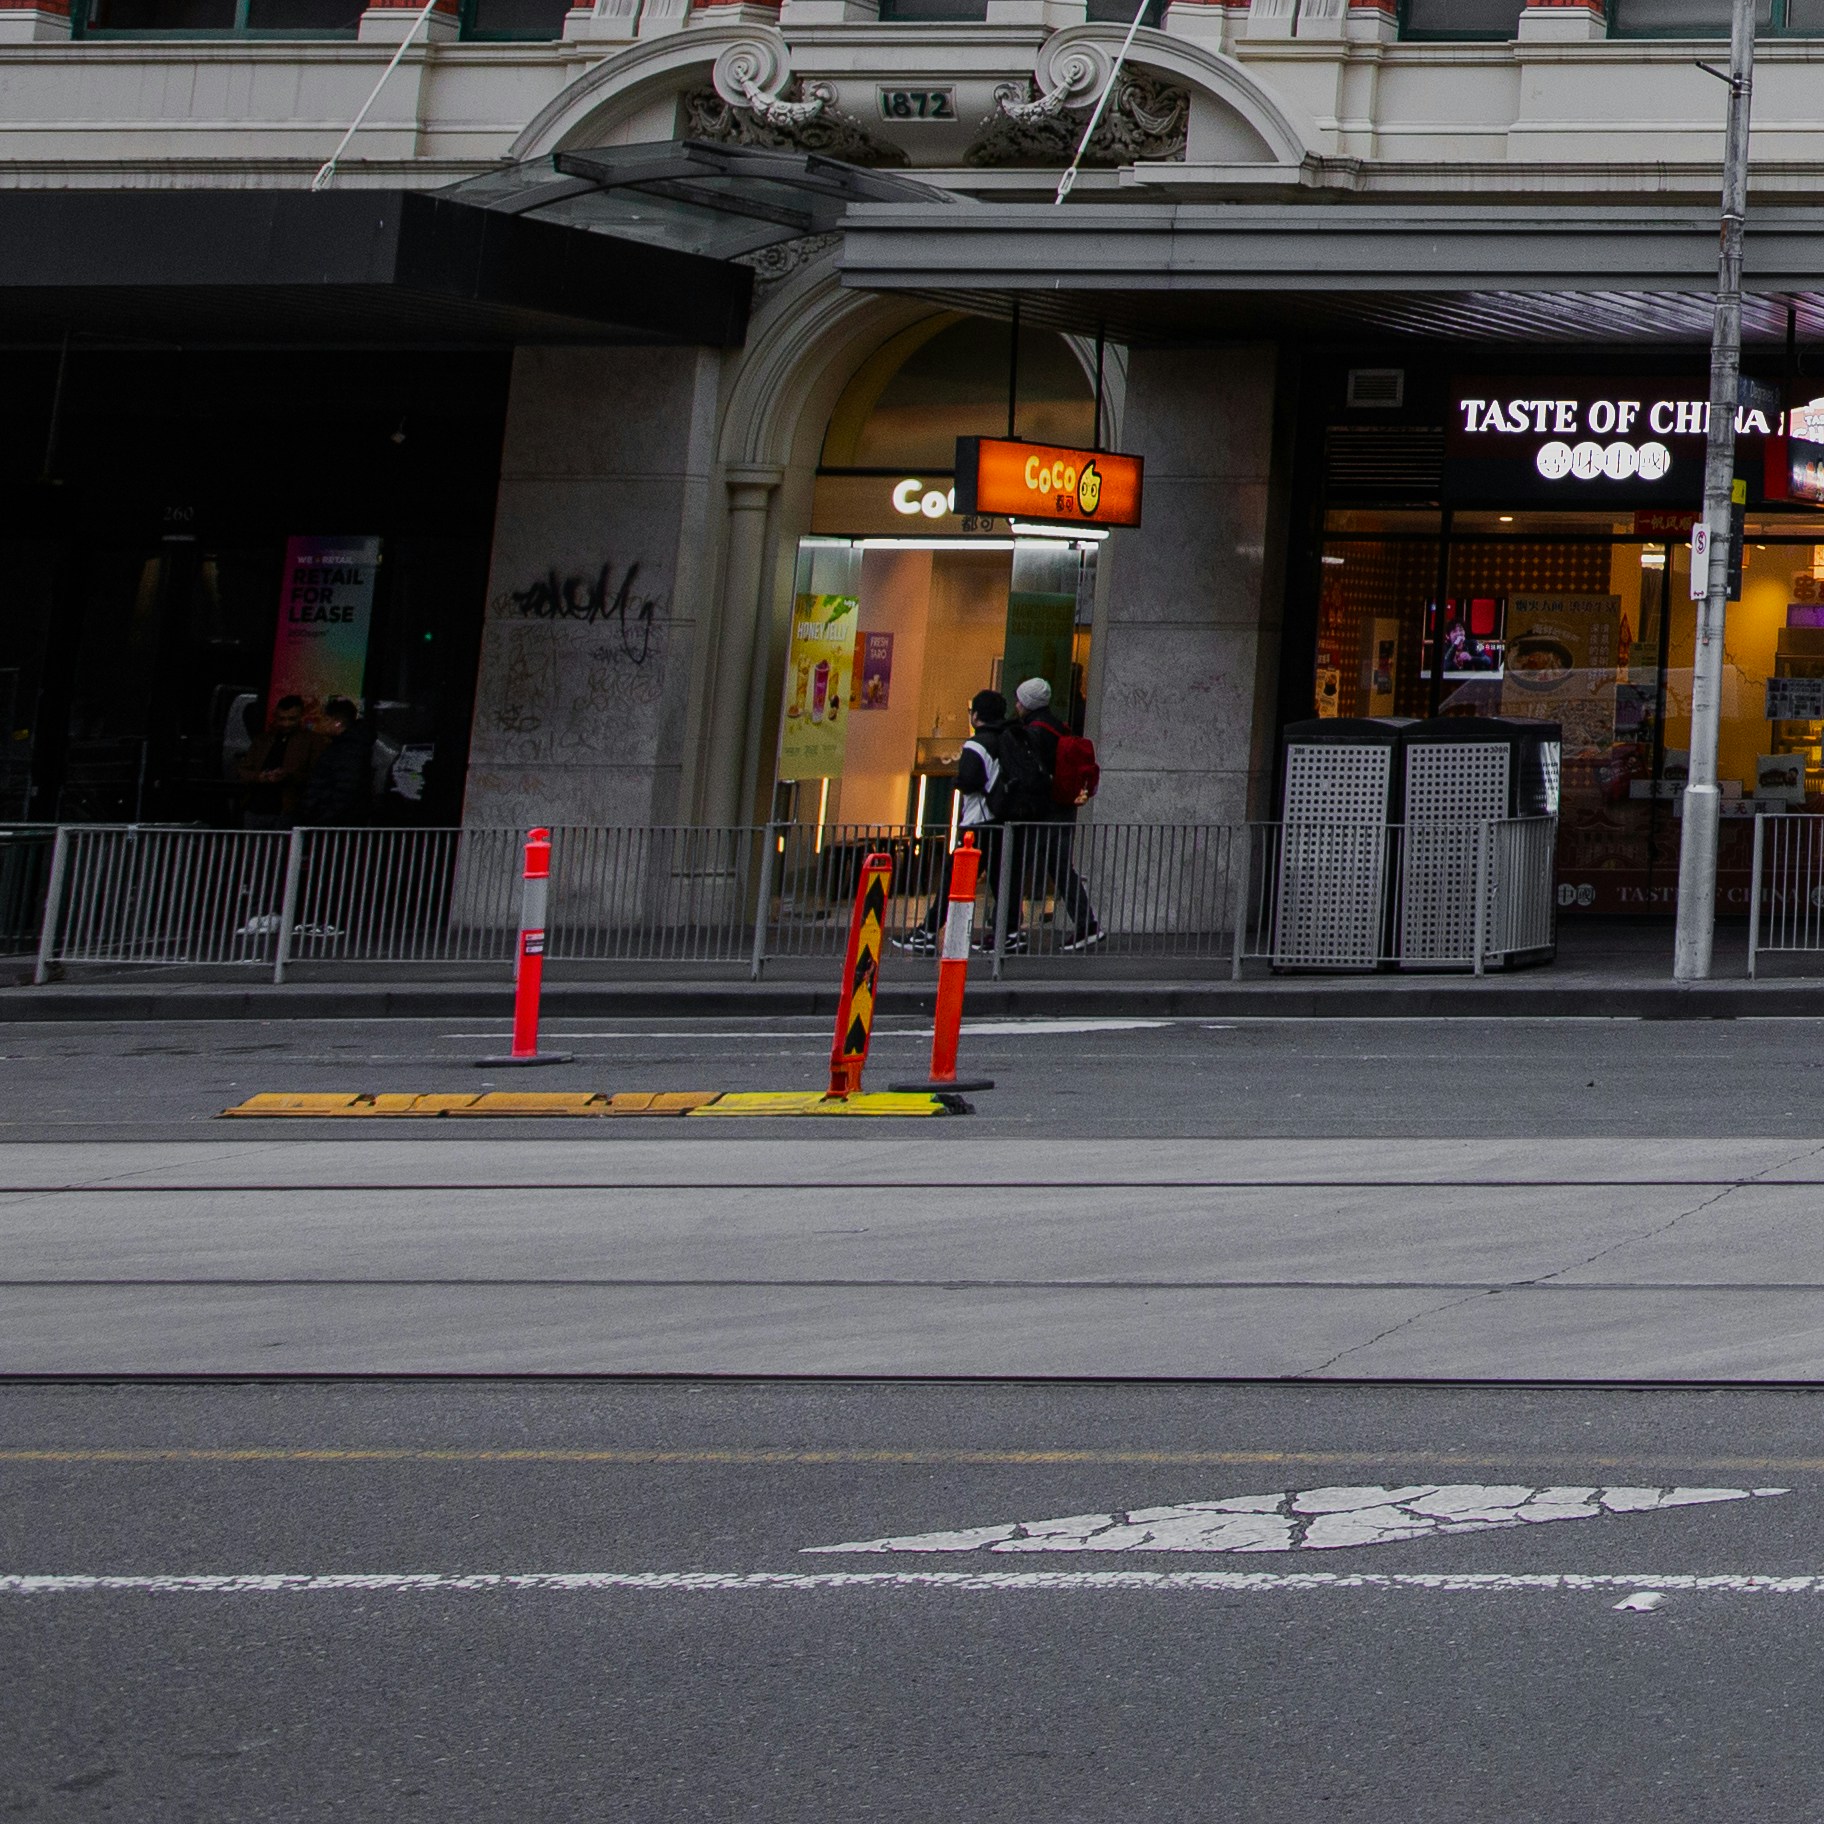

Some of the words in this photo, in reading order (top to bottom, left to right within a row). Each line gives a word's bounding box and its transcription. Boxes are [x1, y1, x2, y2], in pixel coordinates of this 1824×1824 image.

[880, 91, 952, 119] 1872
[1460, 399, 1578, 434] TASTE
[1588, 401, 1641, 435] OF
[1024, 455, 1077, 495] CoCo
[892, 478, 955, 519] Co
[163, 505, 195, 522] 260
[293, 569, 364, 585] RETAIL
[290, 587, 333, 605] FOR
[288, 606, 354, 623] LEASE
[797, 621, 826, 640] HONEY
[869, 636, 889, 648] FRESH
[870, 648, 887, 661] TARO
[1616, 887, 1678, 902] TAST
